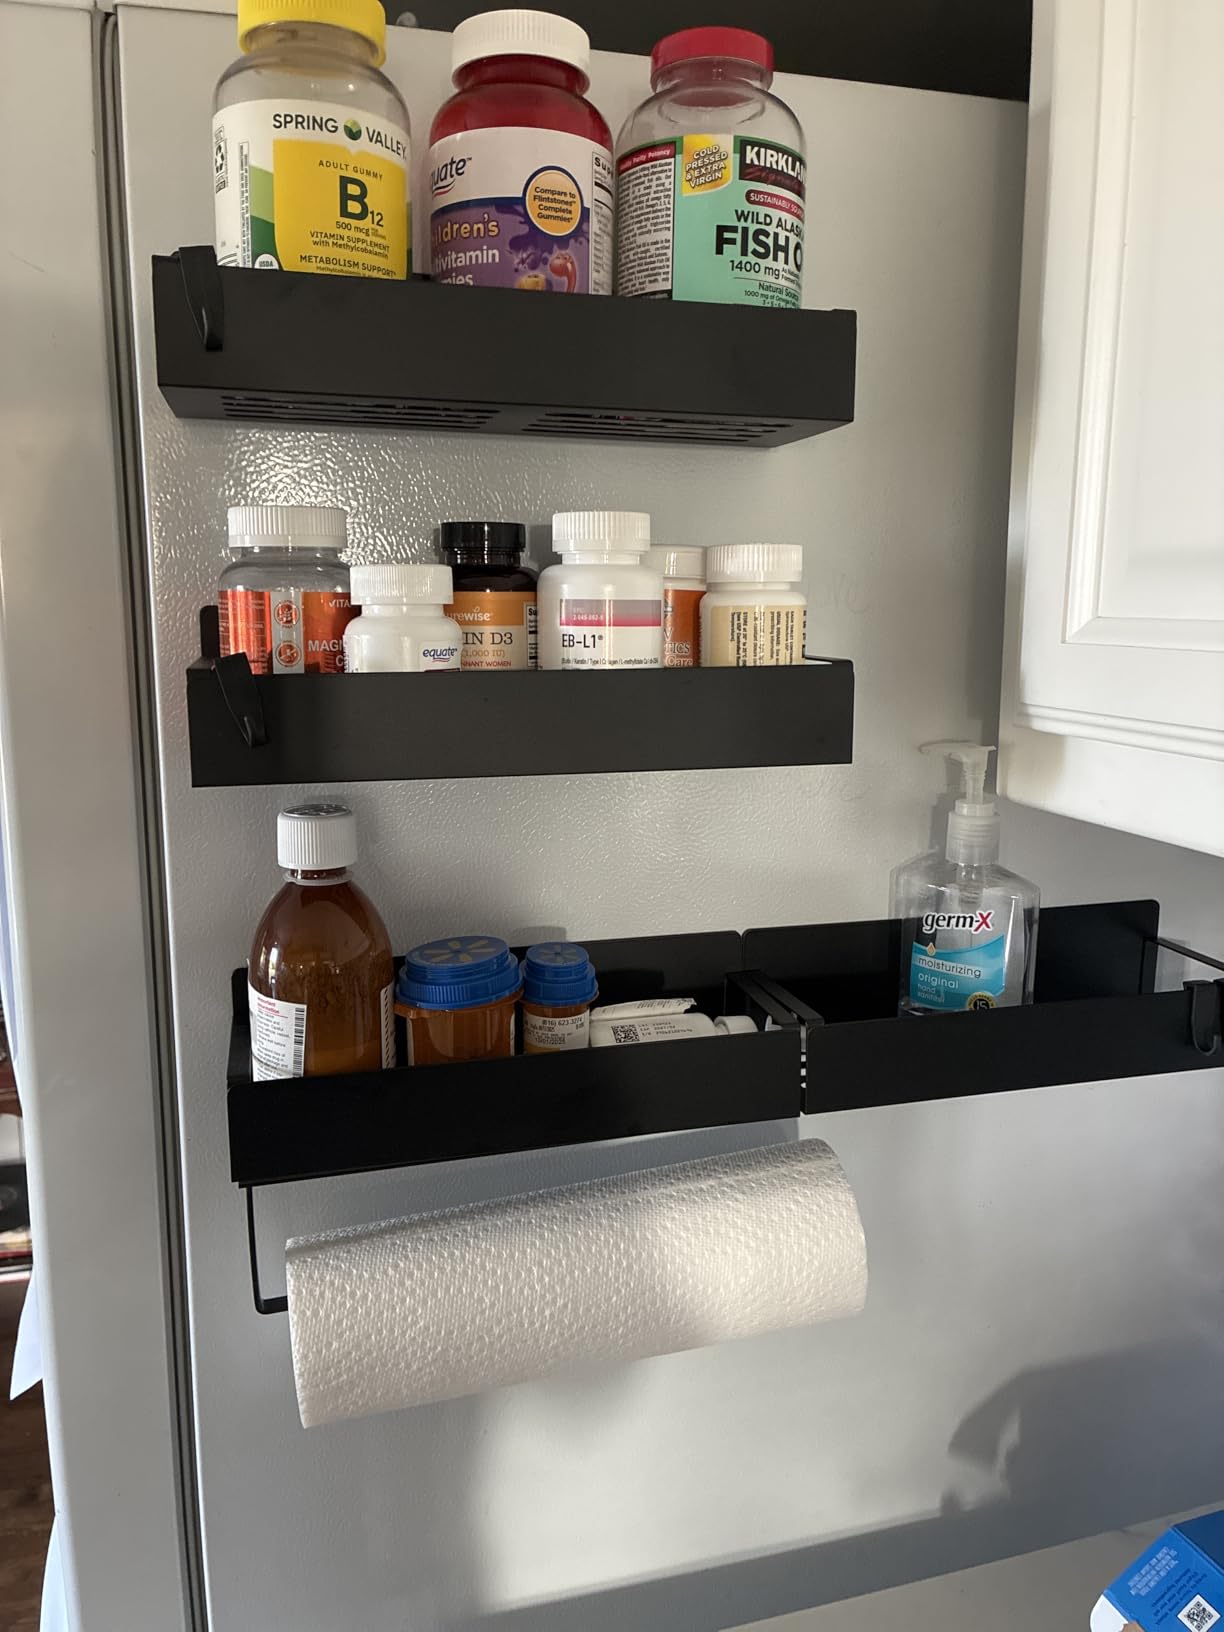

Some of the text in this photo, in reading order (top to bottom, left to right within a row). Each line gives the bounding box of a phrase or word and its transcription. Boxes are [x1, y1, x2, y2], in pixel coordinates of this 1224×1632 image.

[272, 113, 406, 159] SPRING VALLEY
[693, 145, 719, 159] COLD
[686, 152, 728, 172] PRESSED
[318, 160, 383, 181] ADULT GUMMY
[686, 162, 726, 181] & EXTRA
[690, 172, 722, 188] VIRGIN
[534, 186, 567, 197] Compare
[534, 195, 574, 206] Flintstones
[750, 193, 790, 208] SUSTAINABLY
[538, 204, 572, 214] Complete
[735, 209, 773, 226] WILD
[336, 221, 352, 231] 500
[354, 226, 370, 237] mcg
[310, 230, 390, 253] VITAMIN SUPPLEMENT
[715, 225, 790, 266] FISH
[332, 241, 388, 259] Methylcobalamin
[259, 260, 274, 268] USDA
[300, 254, 360, 269] METABOLISM
[730, 260, 761, 273] 1400
[764, 266, 780, 281] mg
[759, 282, 784, 295] Natural
[491, 632, 513, 645] D3
[422, 646, 456, 660] equate
[924, 912, 992, 932] germ-X
[918, 957, 982, 978] moisturizing
[918, 972, 959, 989] original
[918, 984, 936, 993] hand
